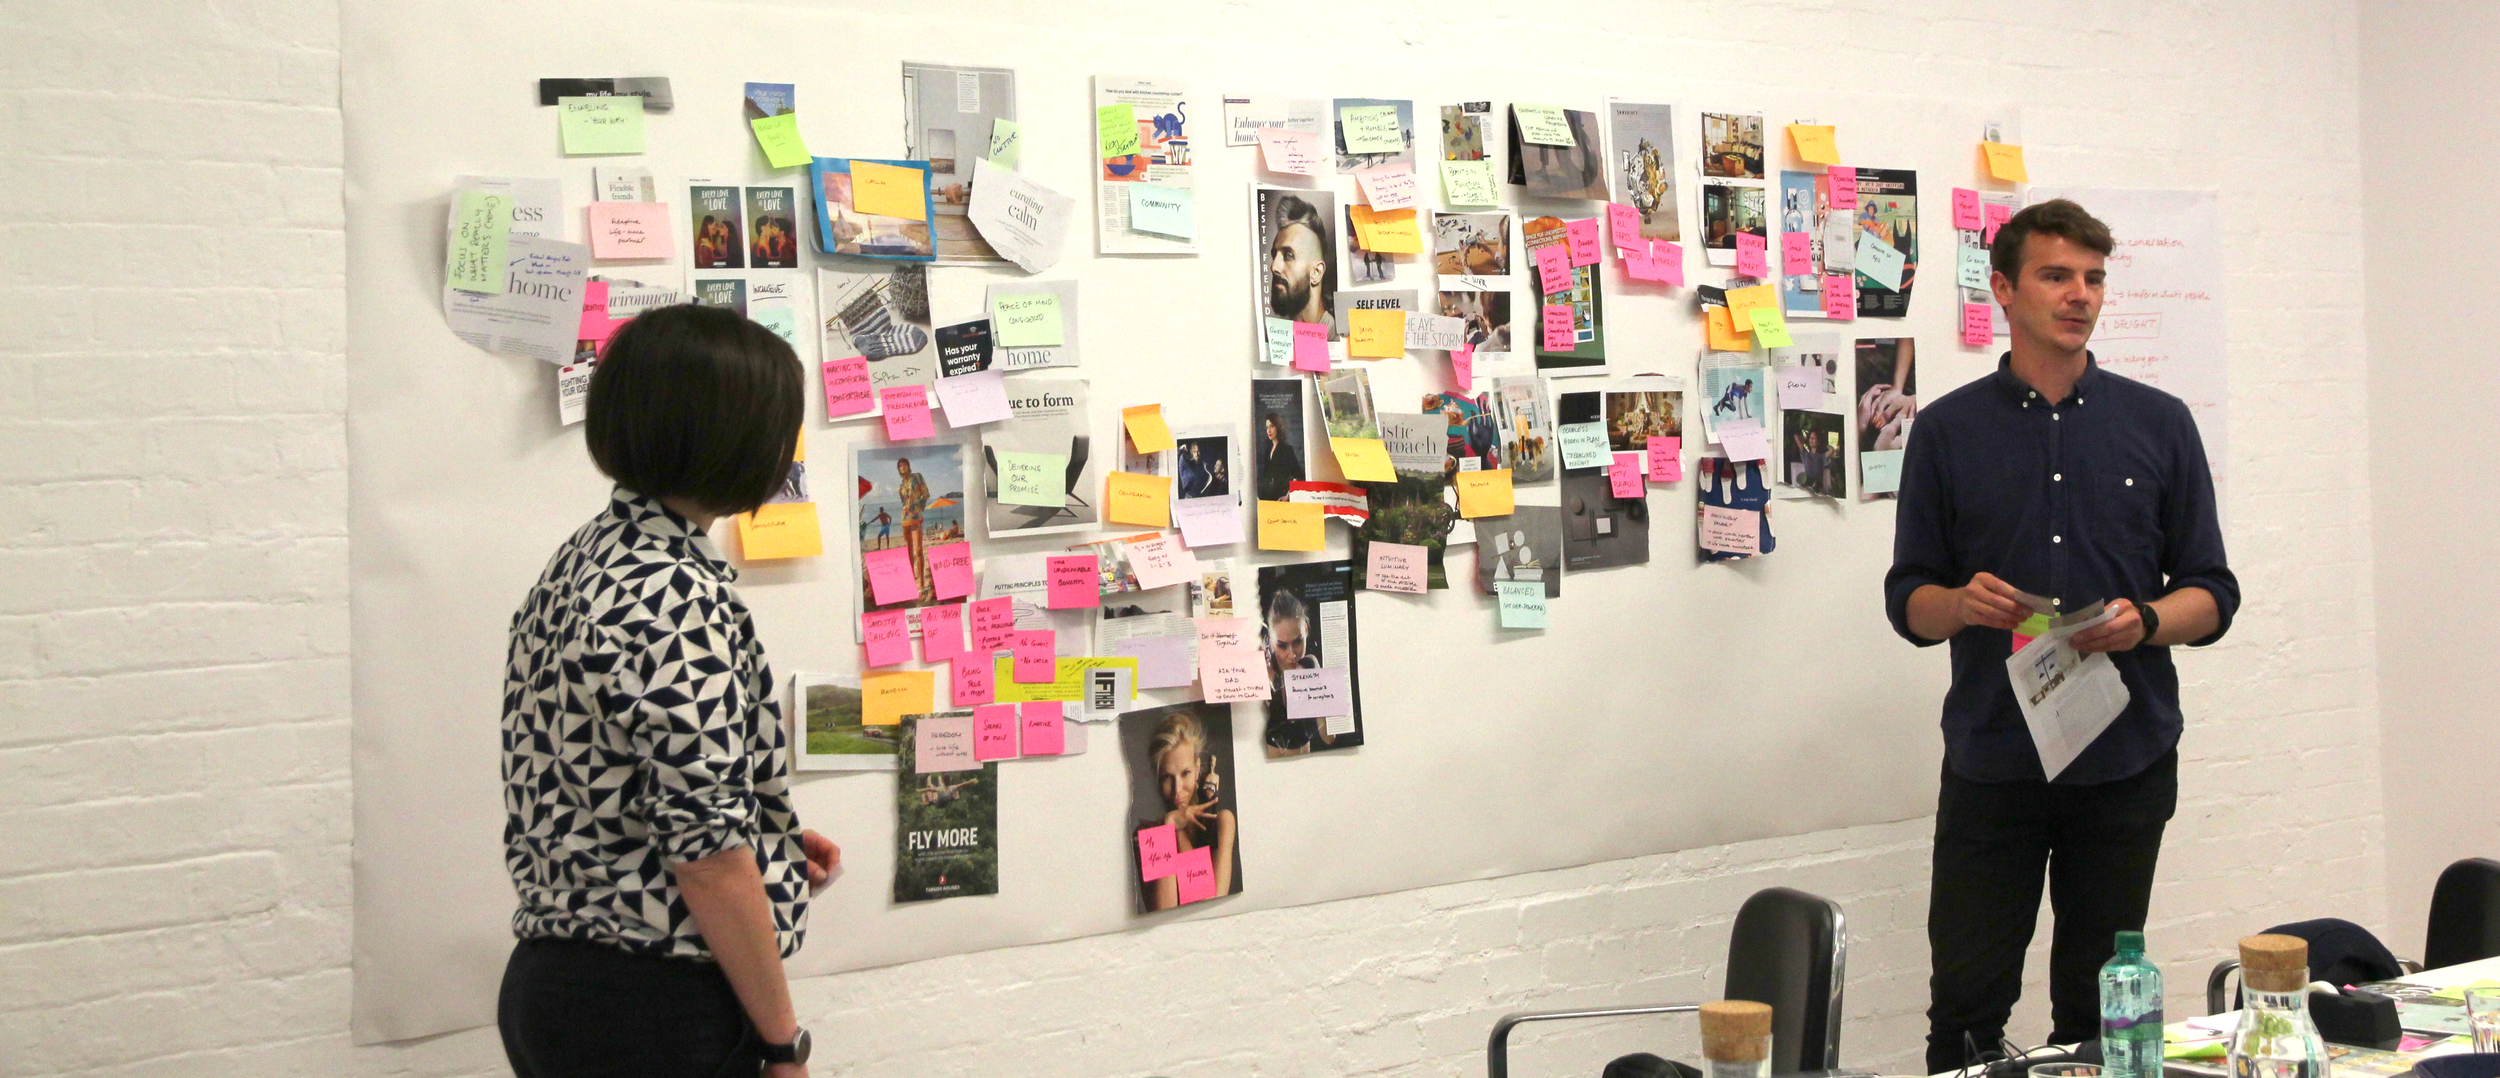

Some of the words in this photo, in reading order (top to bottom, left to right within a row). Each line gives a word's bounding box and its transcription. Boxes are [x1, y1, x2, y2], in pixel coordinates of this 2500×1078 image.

[702, 190, 716, 198] EVERY
[716, 189, 729, 198] LOVE
[756, 190, 770, 198] EVERY
[771, 190, 783, 198] LOVE
[709, 198, 727, 211] LOVE
[763, 199, 781, 211] LOVE
[1009, 187, 1044, 215] curating
[1141, 198, 1181, 213] COMMUNITY
[1007, 204, 1038, 231] calm
[2128, 237, 2184, 248] conversation
[454, 247, 467, 279] FOCUS
[461, 222, 470, 238] ON
[481, 236, 491, 281] MATTERS
[509, 271, 572, 302] home
[707, 283, 722, 292] EVERY
[722, 281, 735, 291] LOVE
[1263, 253, 1271, 315] FREUND
[714, 291, 733, 304] LOVE
[1023, 300, 1034, 308] OF
[1036, 298, 1053, 307] MIND
[1356, 300, 1375, 310] SELF
[1376, 298, 1401, 309] LEVEL
[1418, 318, 1434, 331] AYE
[2114, 319, 2157, 329] DELIGHT
[1410, 333, 1429, 346] THE
[1433, 333, 1464, 347] STORM
[945, 346, 960, 356] Has
[960, 343, 978, 354] your
[1006, 346, 1051, 366] home
[947, 353, 981, 366] warranty
[949, 362, 981, 376] expired?
[561, 375, 587, 388] FIGHTING
[562, 386, 576, 397] YOUR
[1026, 396, 1040, 407] to
[1043, 392, 1074, 407] form
[1382, 421, 1414, 440] istic
[1008, 460, 1042, 472] DELIVERING
[1011, 473, 1028, 483] OUR
[994, 581, 1014, 590] PUTTING
[1014, 580, 1041, 589] PRINCIPLES
[927, 628, 938, 638] OF
[1215, 639, 1239, 648] Together
[909, 830, 933, 850] FLY
[937, 827, 978, 848] MORE
